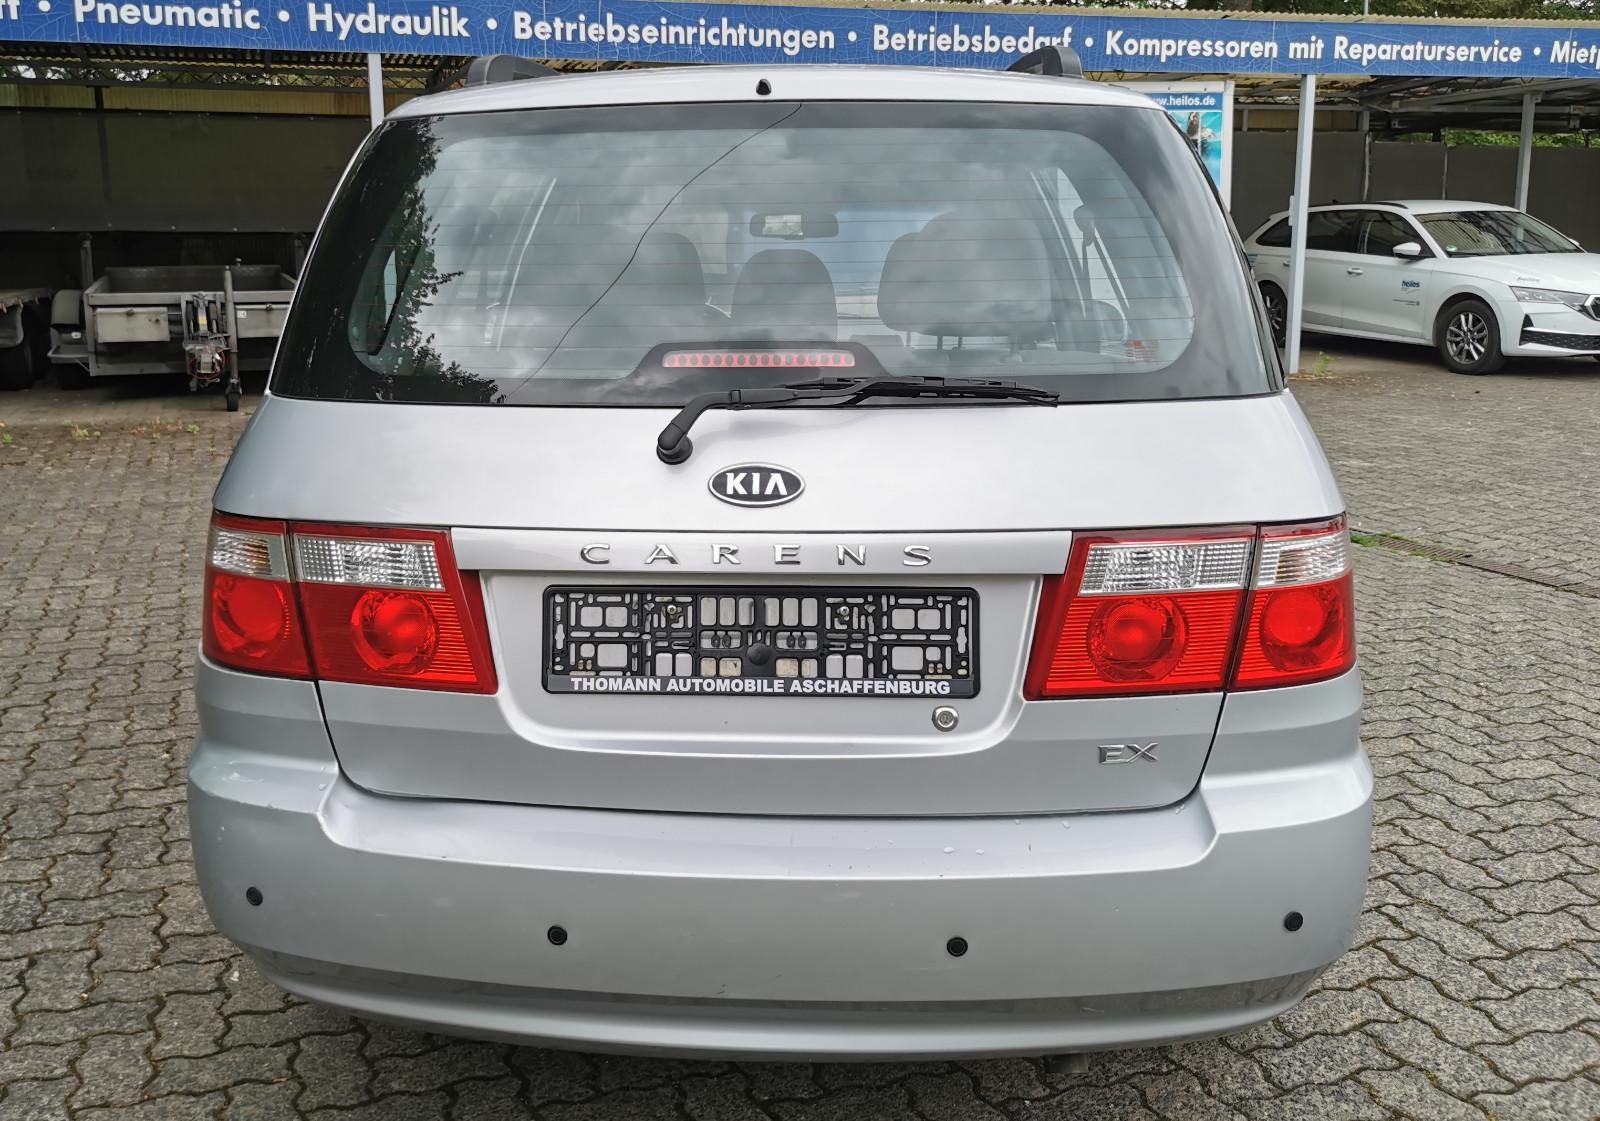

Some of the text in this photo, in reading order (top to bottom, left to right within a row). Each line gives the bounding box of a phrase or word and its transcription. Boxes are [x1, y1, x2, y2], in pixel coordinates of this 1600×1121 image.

[75, 0, 260, 30] Pneumatic
[308, 3, 469, 41] Hydraulik
[513, 11, 836, 56] Betriebseinrichtungen
[873, 24, 1073, 53] Betriebsbedarf
[1105, 30, 1279, 63] Kompressoren
[1288, 35, 1325, 59] mit
[1334, 36, 1522, 66] Reparaturservice
[725, 472, 788, 496] KIA
[580, 543, 932, 567] CARENS
[570, 677, 951, 695] THOMANN AUTOMOBILE ASCHAFFENBURG
[1097, 742, 1159, 764] EX
